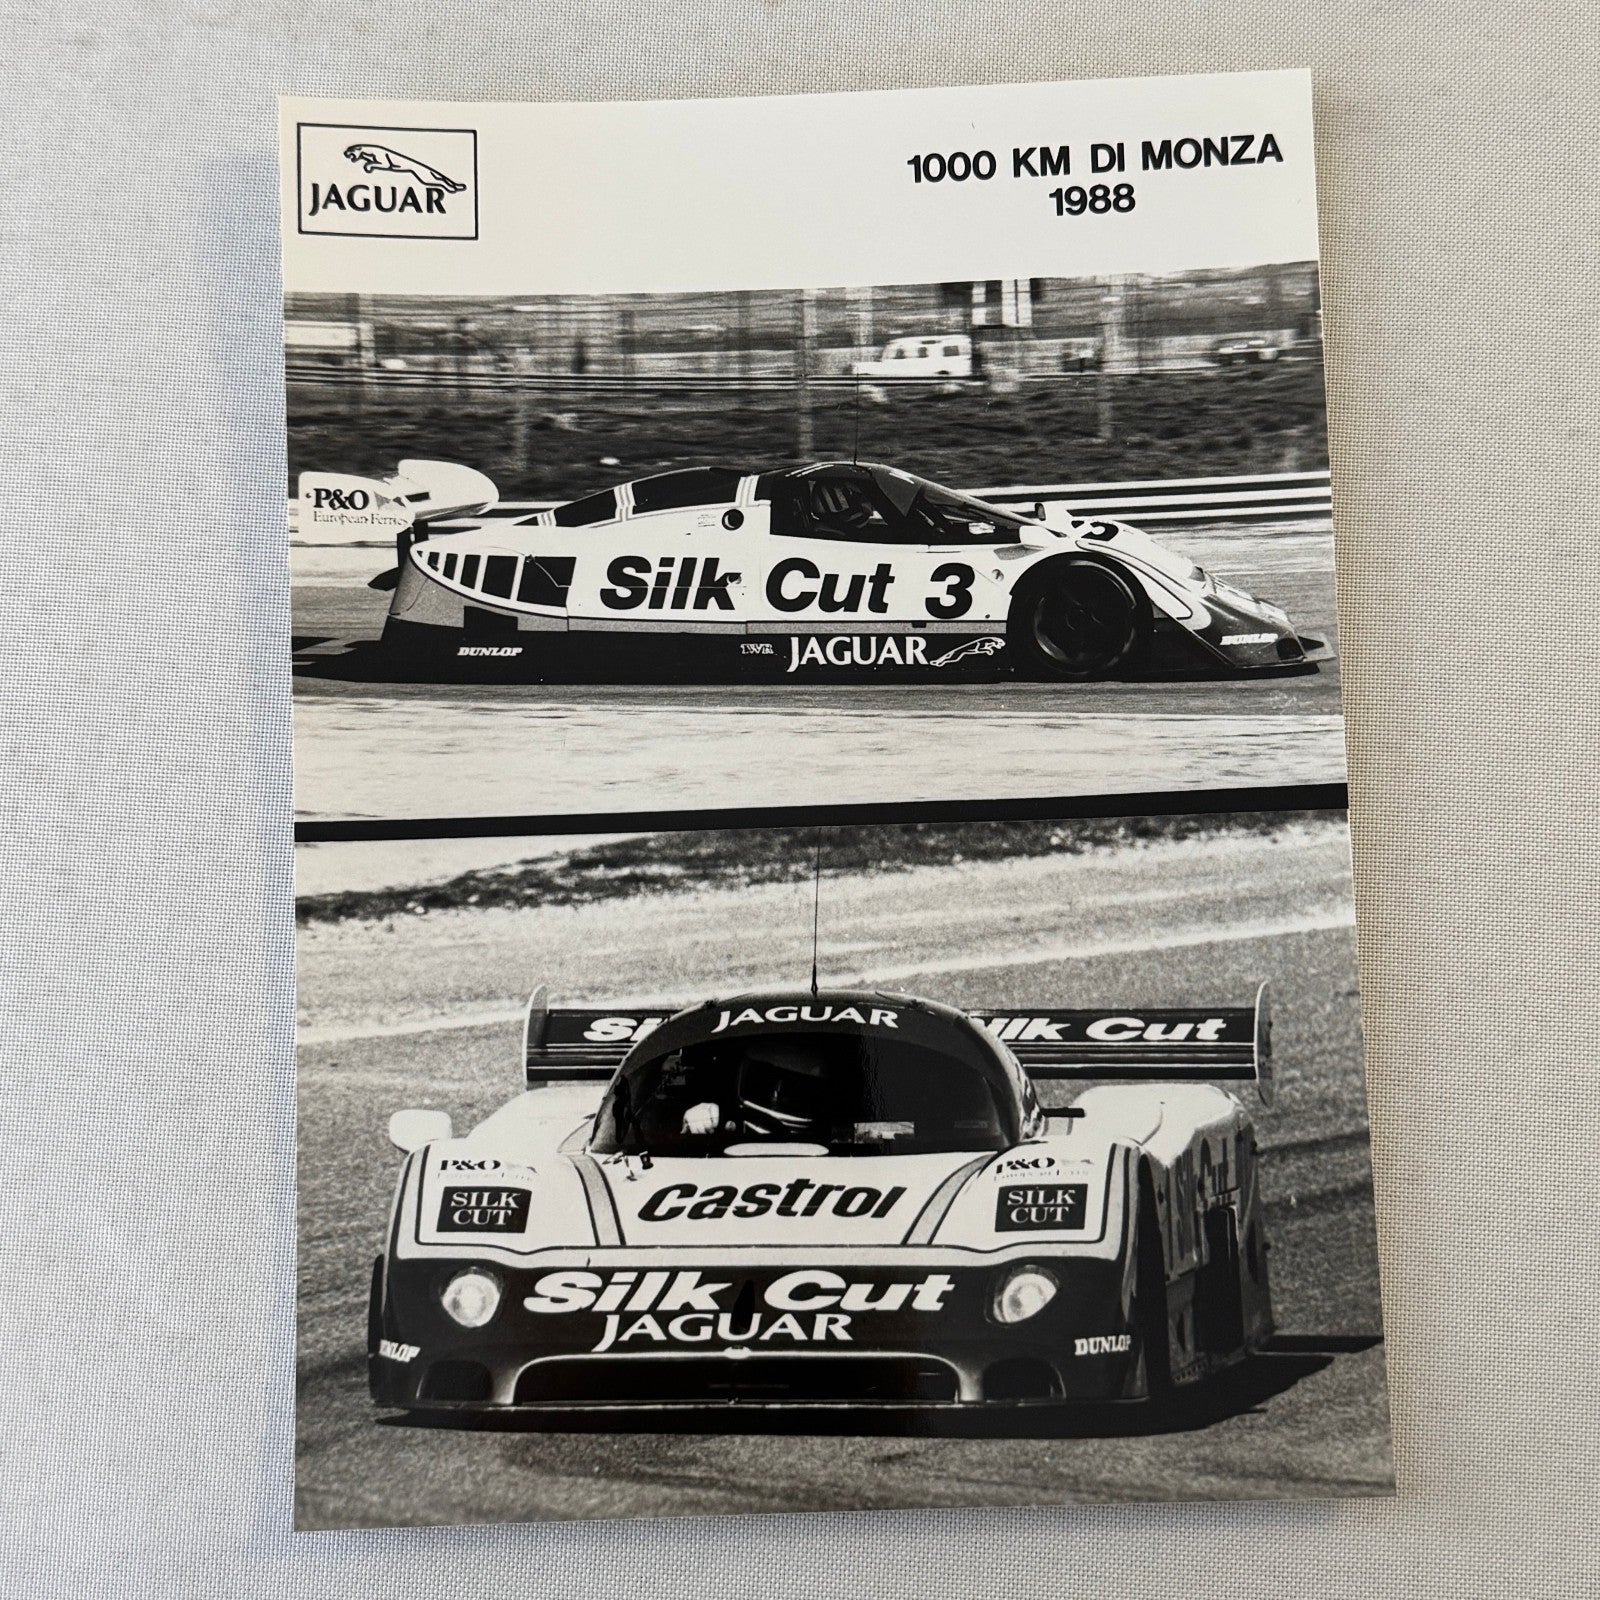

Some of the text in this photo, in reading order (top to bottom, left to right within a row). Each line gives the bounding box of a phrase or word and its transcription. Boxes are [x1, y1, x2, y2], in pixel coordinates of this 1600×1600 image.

[907, 133, 1284, 183] 1000 KM DI MONZA
[308, 182, 446, 216] JAGUAR
[1049, 183, 1136, 216] 1988
[313, 488, 370, 510] P&O
[600, 555, 975, 619] Silk Cut 3
[457, 647, 523, 656] DUNLOP
[786, 636, 930, 672] JAGUAR
[583, 1017, 669, 1042] Si
[711, 1006, 899, 1033] JAGUAR
[969, 1017, 1227, 1040] ilk Cut
[440, 1159, 501, 1171] P&O
[450, 1191, 521, 1208] SILK
[637, 1178, 907, 1222] Castrol
[1006, 1189, 1076, 1206] SILK
[453, 1208, 512, 1226] CUT
[1010, 1206, 1070, 1224] CUT
[523, 1269, 955, 1313] Silk Cut
[591, 1312, 853, 1352] JAGUAR
[1074, 1334, 1131, 1356] DUNLOP
